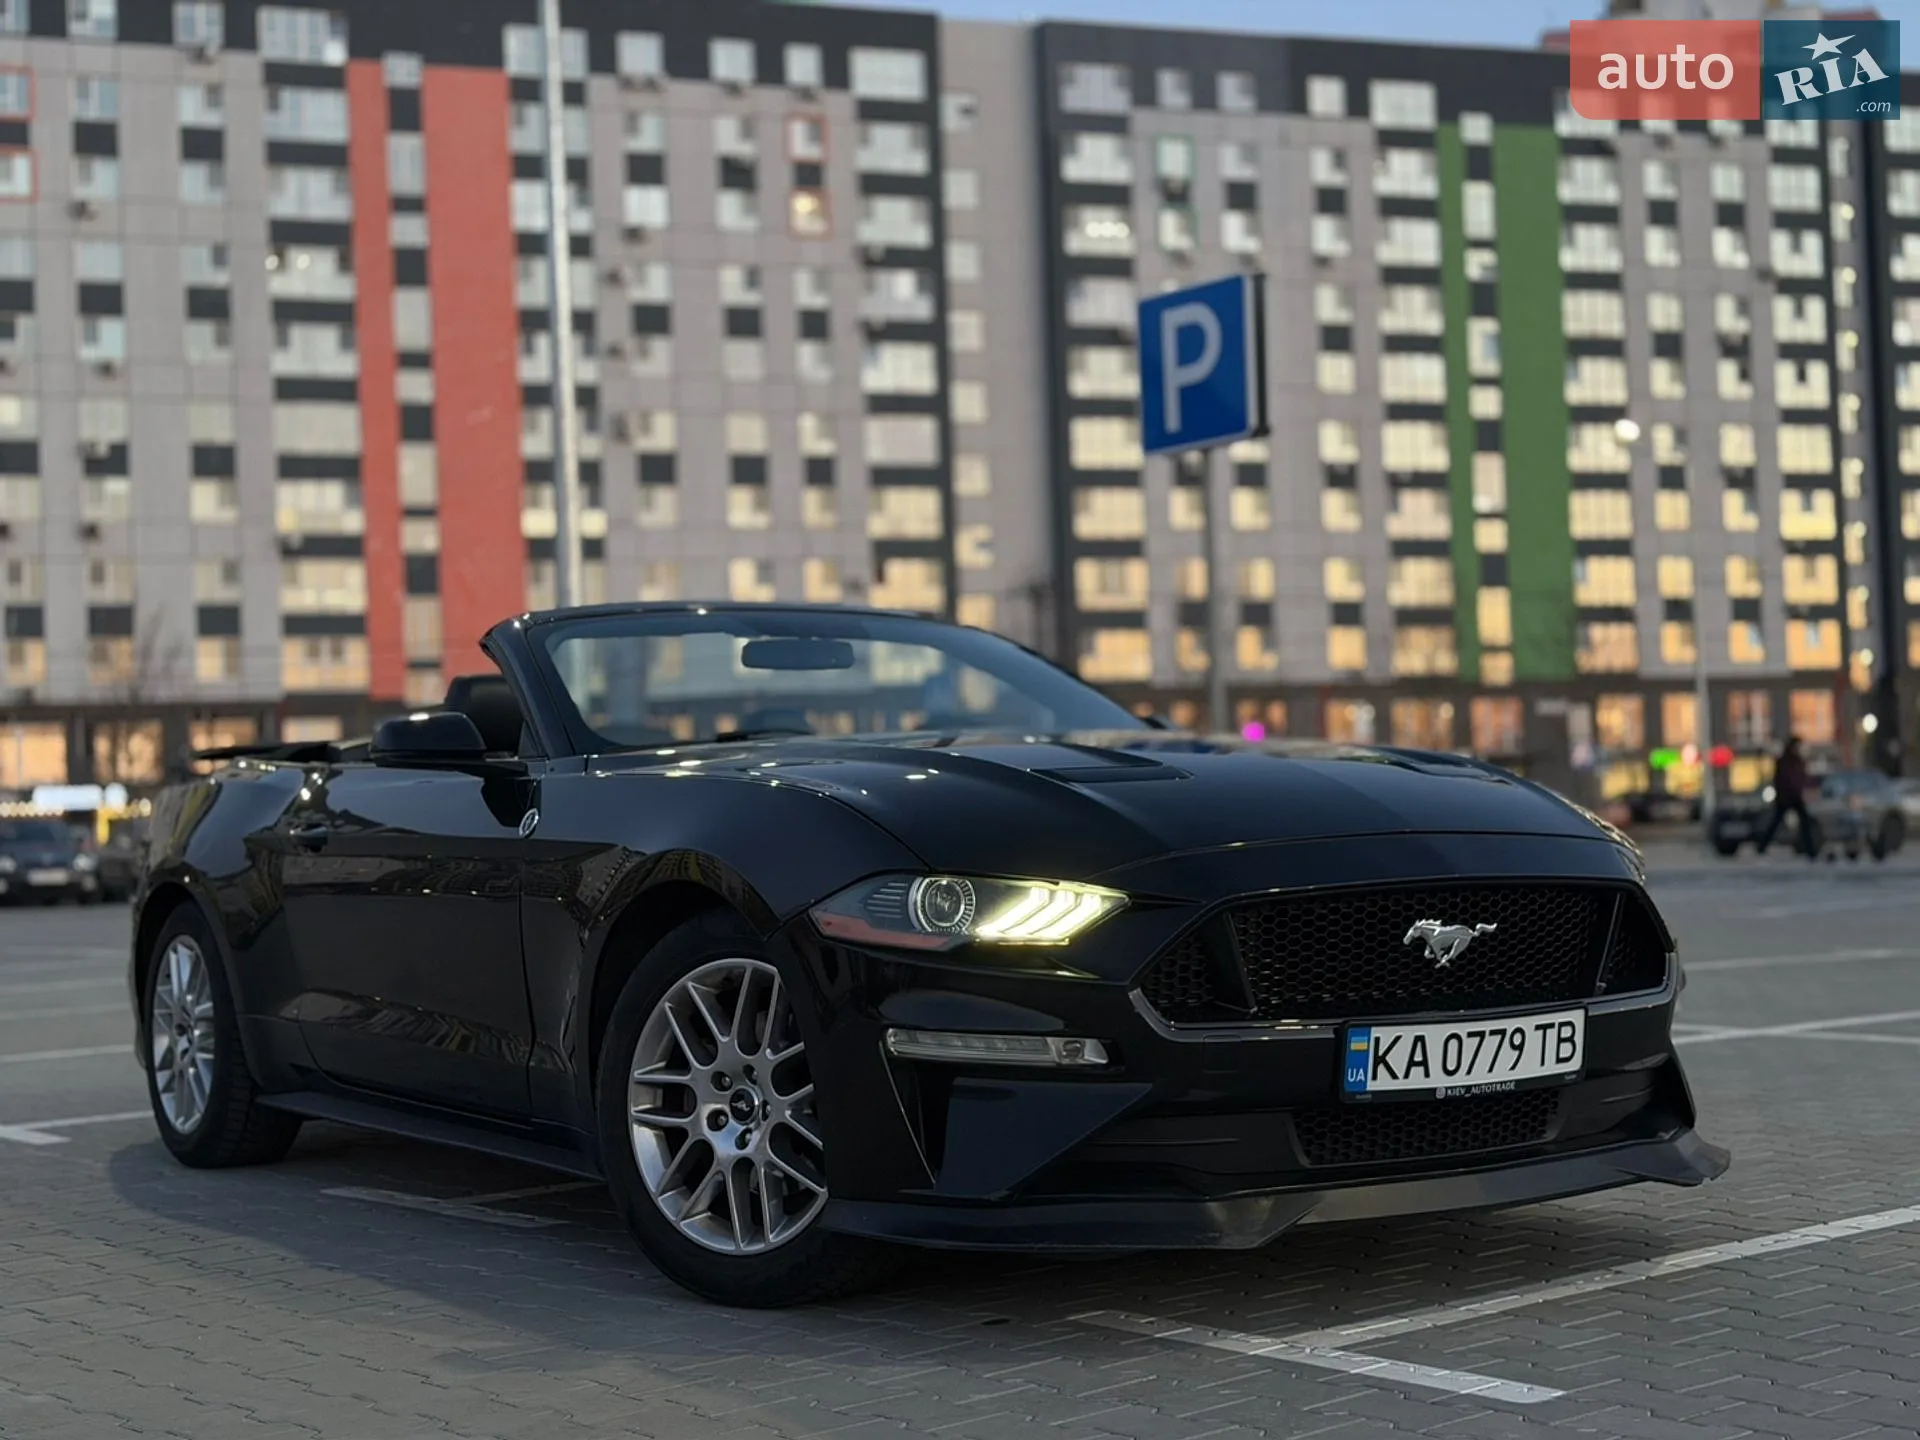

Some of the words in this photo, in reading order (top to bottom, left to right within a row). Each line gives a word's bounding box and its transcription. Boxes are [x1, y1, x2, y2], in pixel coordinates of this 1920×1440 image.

[1161, 301, 1223, 434] P
[1347, 1068, 1366, 1082] UA
[1371, 1034, 1432, 1081] KA
[1441, 1026, 1527, 1077] 0779
[1533, 1020, 1577, 1067] TB
